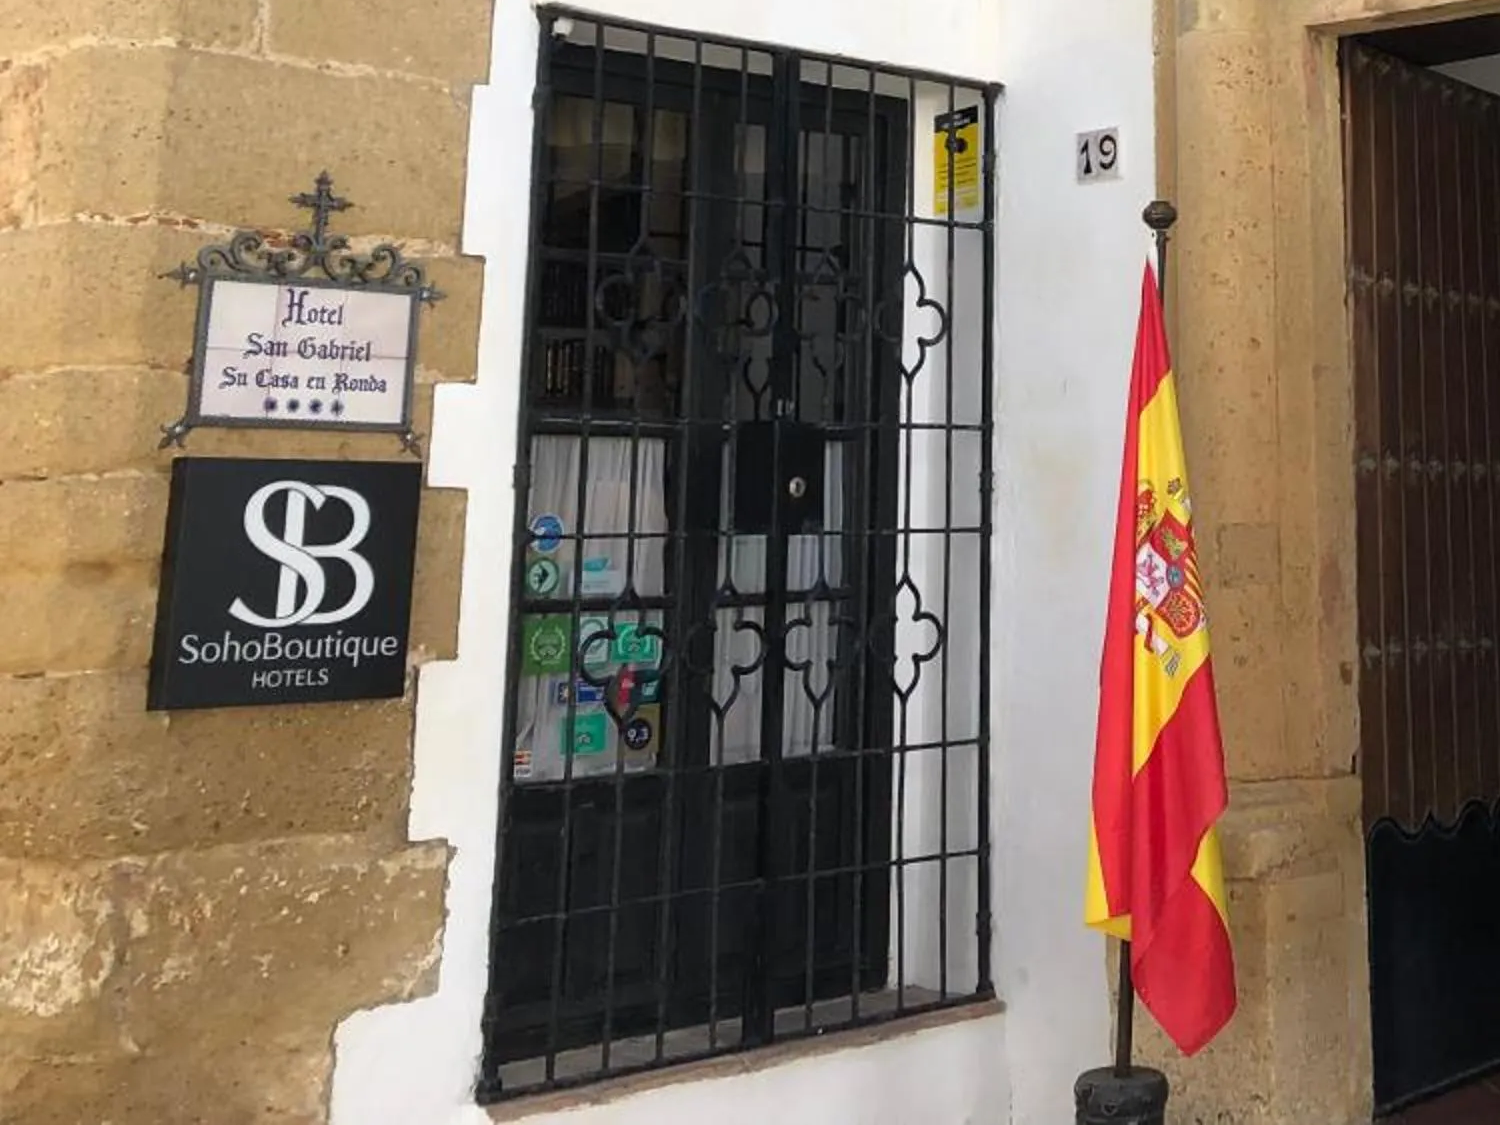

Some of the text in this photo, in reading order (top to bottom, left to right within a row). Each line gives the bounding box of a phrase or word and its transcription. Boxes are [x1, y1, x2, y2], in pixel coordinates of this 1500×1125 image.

[1080, 134, 1117, 176] 19
[282, 288, 344, 327] Hotel
[243, 332, 372, 362] San Gabriel
[255, 369, 300, 389] Casa
[306, 375, 326, 390] en
[332, 372, 388, 394] Ronda
[178, 629, 399, 668] SohoBoutique
[251, 668, 330, 690] HOTELS
